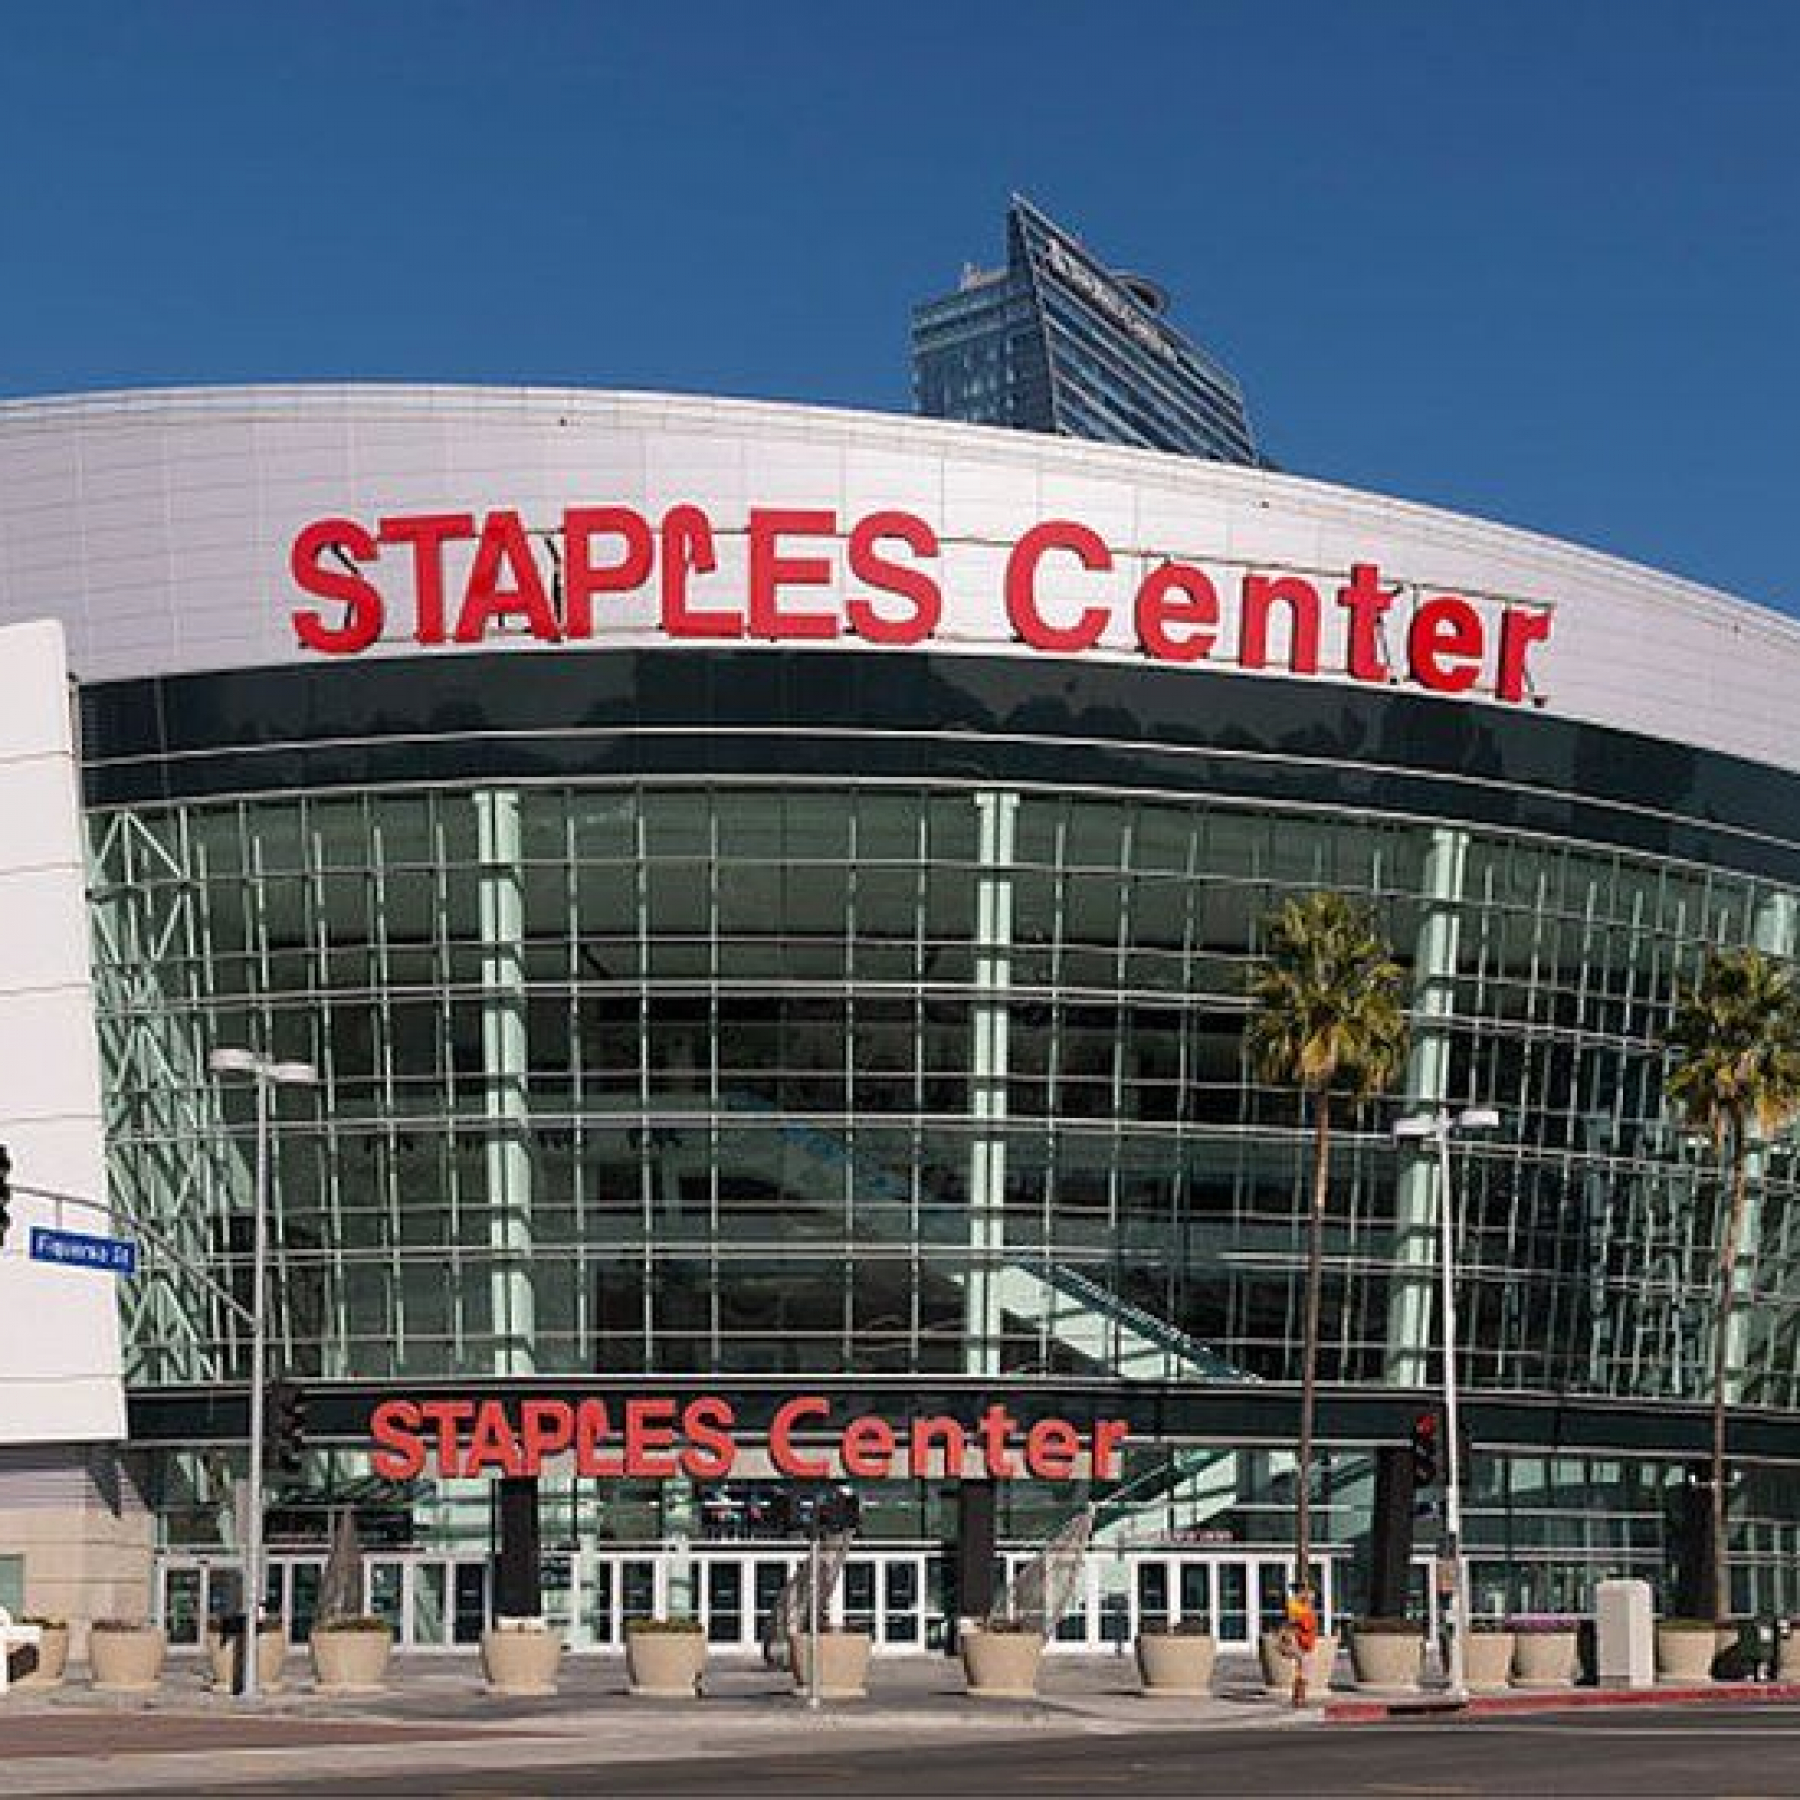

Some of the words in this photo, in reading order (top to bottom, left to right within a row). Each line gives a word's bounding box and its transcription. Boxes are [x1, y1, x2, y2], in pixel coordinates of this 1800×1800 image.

[291, 503, 942, 655] STAPLES
[1003, 518, 1554, 703] Center
[370, 1397, 736, 1480] STAPLES
[768, 1396, 1130, 1480] Center
